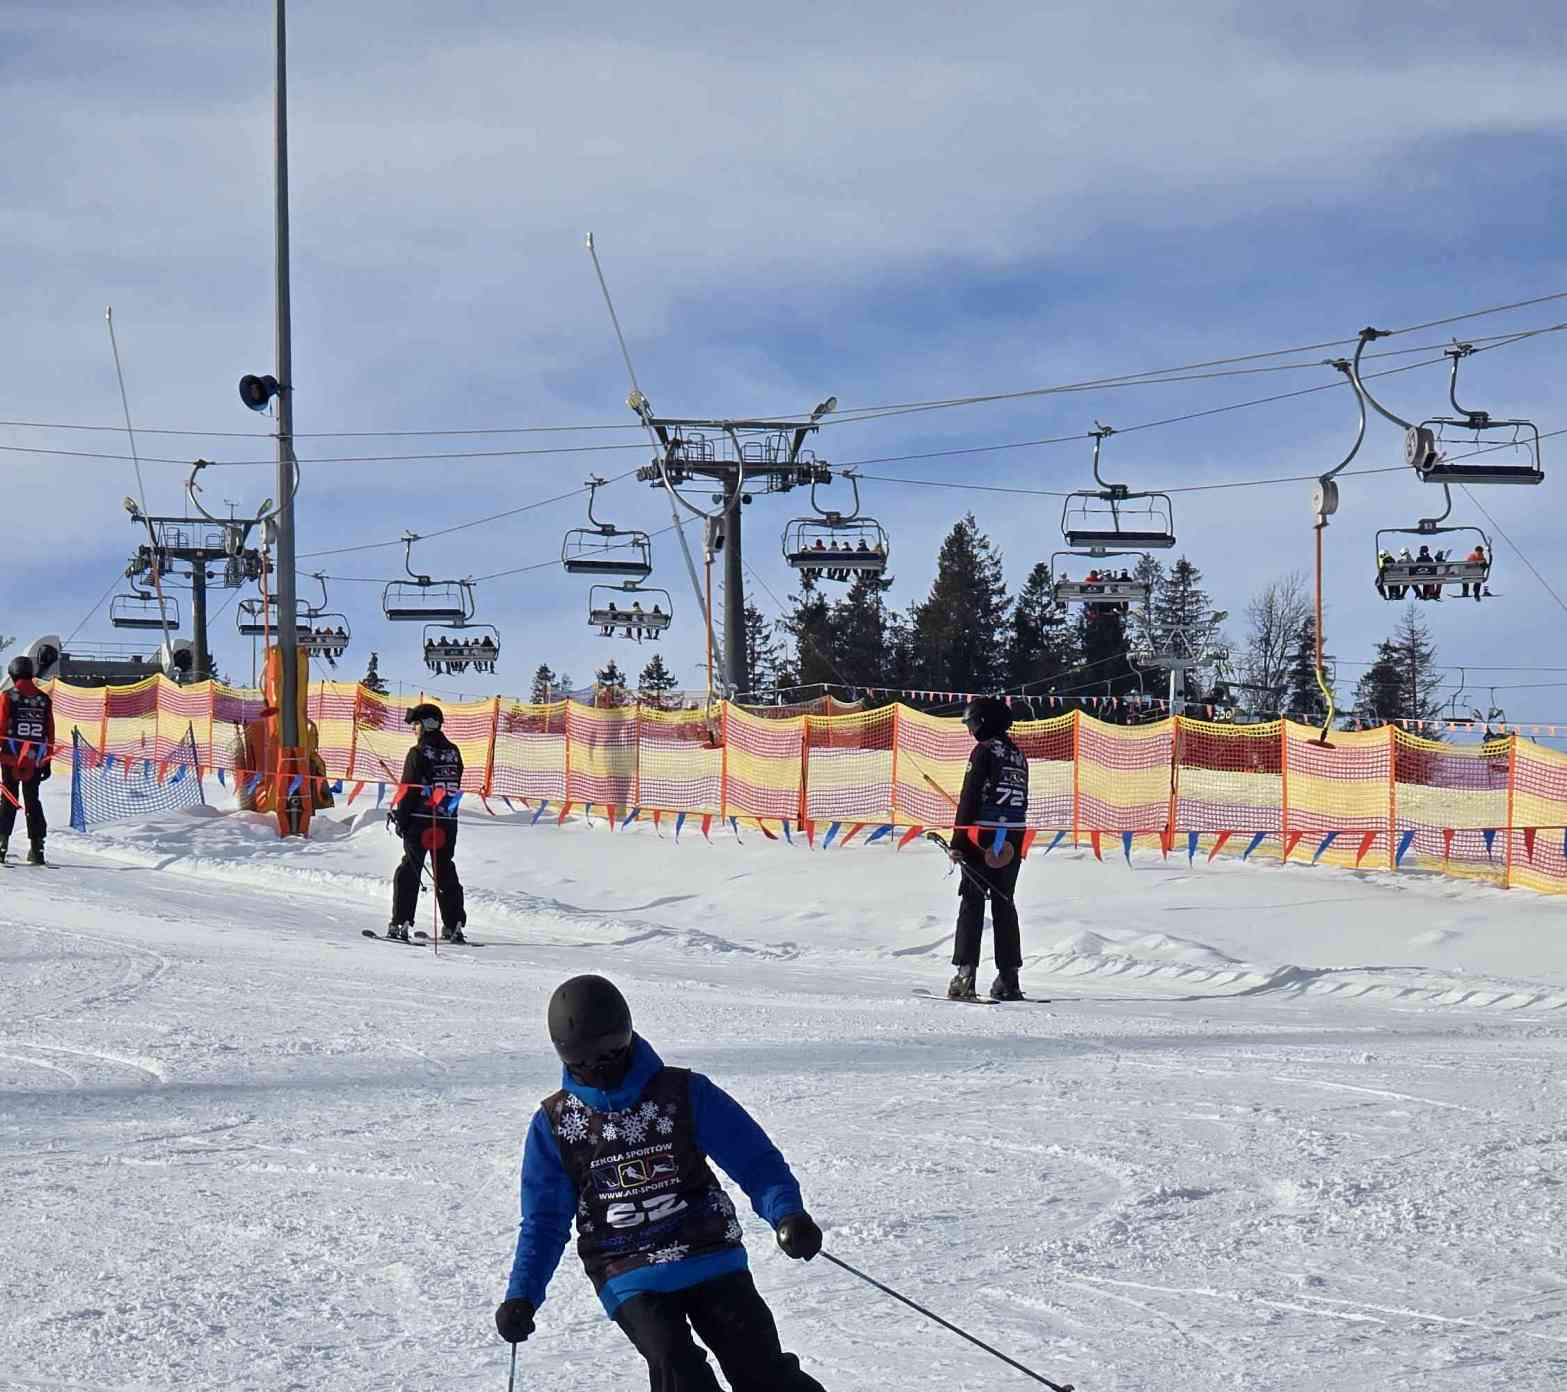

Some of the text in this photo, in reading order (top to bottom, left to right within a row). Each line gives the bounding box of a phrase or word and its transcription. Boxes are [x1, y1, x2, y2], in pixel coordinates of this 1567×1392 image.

[17, 722, 43, 737] 82
[995, 787, 1025, 806] 72
[606, 1193, 688, 1229] 62
